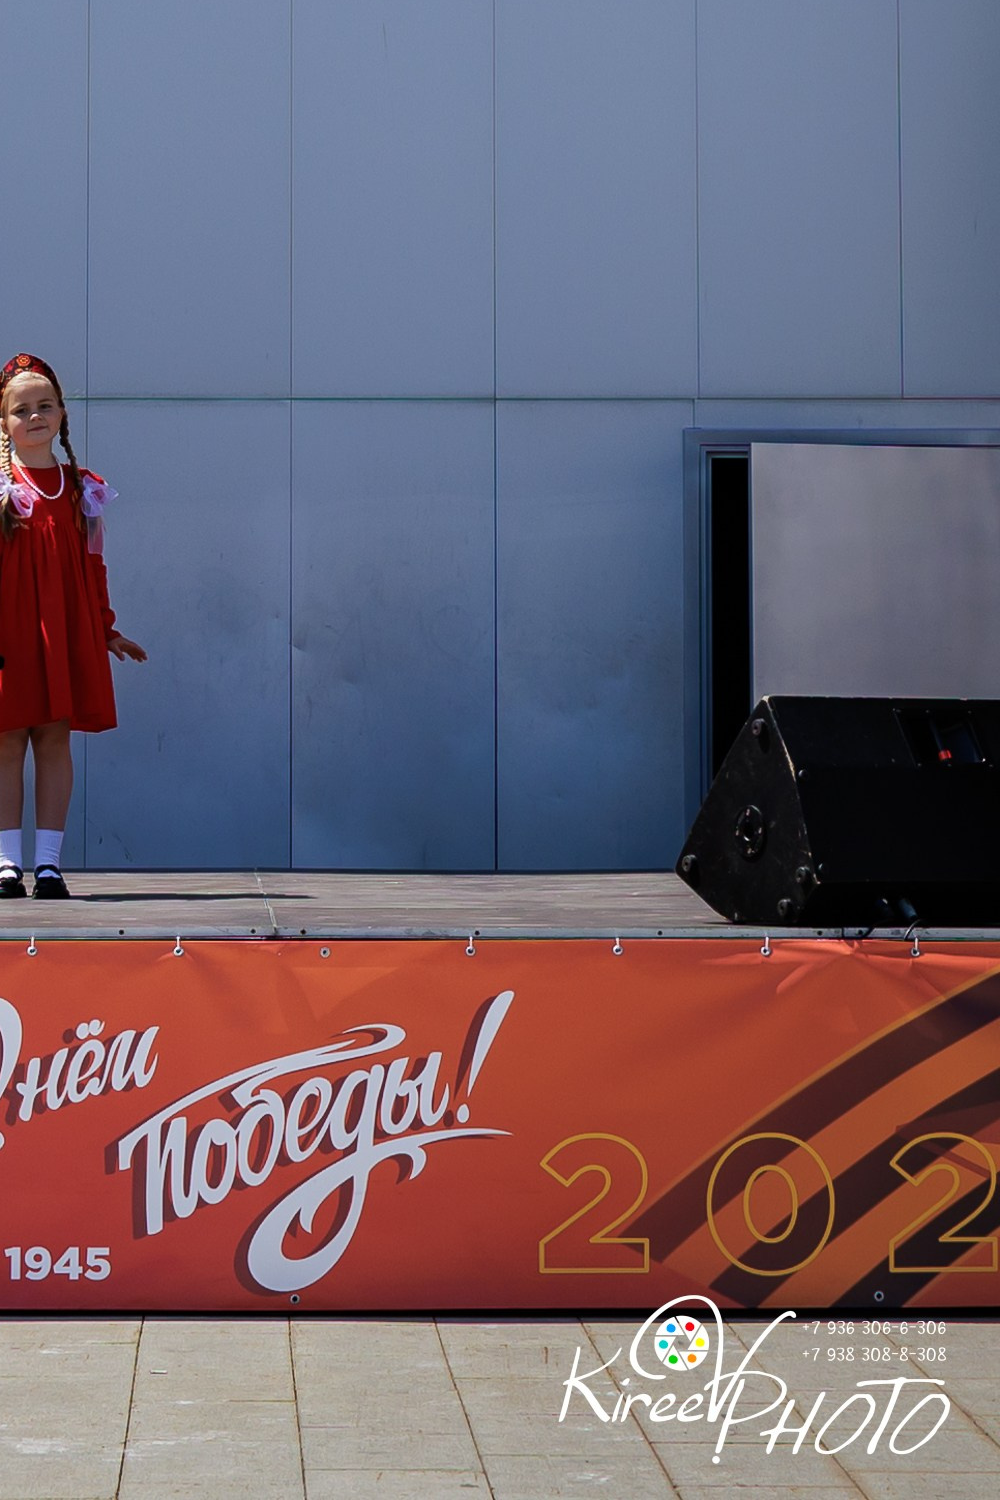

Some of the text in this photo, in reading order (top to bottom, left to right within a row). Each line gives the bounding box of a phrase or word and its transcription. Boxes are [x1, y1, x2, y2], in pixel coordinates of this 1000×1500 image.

[118, 990, 515, 1292] Победы!
[539, 1132, 999, 1277] 202
[4, 1246, 112, 1281] 1945
